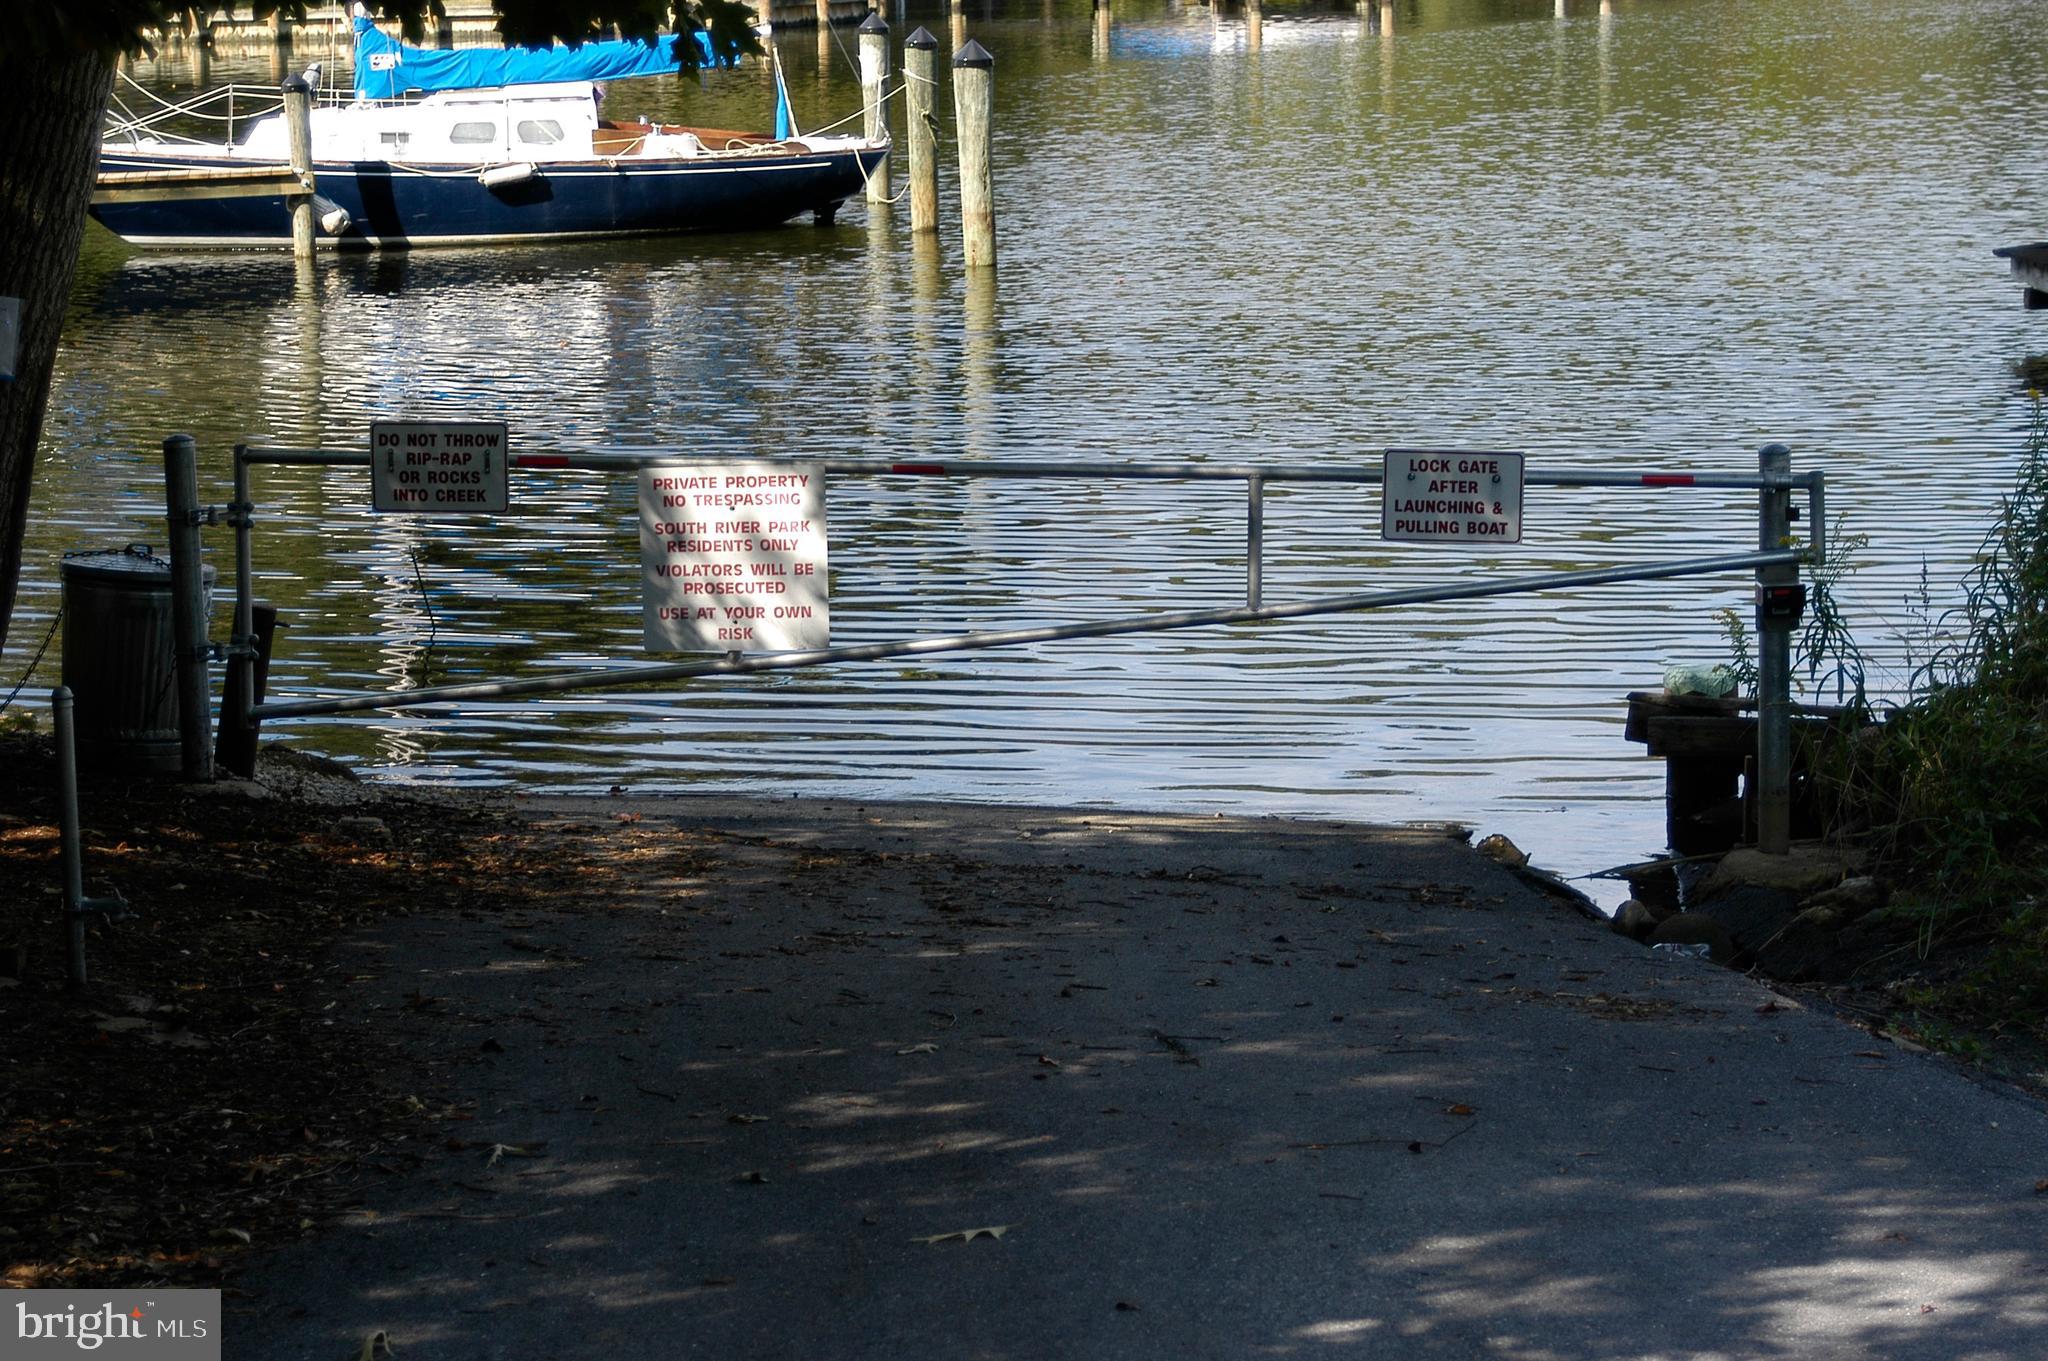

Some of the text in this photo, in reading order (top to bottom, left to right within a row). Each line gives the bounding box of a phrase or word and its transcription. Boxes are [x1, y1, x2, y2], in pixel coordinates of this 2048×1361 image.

[379, 434, 499, 447] DO NOT THROW
[407, 453, 472, 465] RIP-RAP
[1410, 459, 1498, 473] LOCK GATE
[399, 471, 480, 484] OR ROCKS
[653, 475, 808, 490] PRIVATE PROPERTY
[1429, 480, 1478, 493] AFTER
[394, 489, 486, 502] INTO CREEK
[663, 493, 801, 507] NO TRESPASSING
[1395, 500, 1503, 514] LAUNCHING &
[655, 521, 811, 535] SOUTH RIVER PARK
[1396, 520, 1508, 535] PULLING BOAT
[667, 539, 798, 552] RESIDENTS ONLY
[656, 563, 813, 577] VIOLATORS WILL BE
[684, 582, 786, 594] PROSECUTED
[660, 607, 812, 620] USE AT YOUR OWN
[718, 628, 753, 639] RISK
